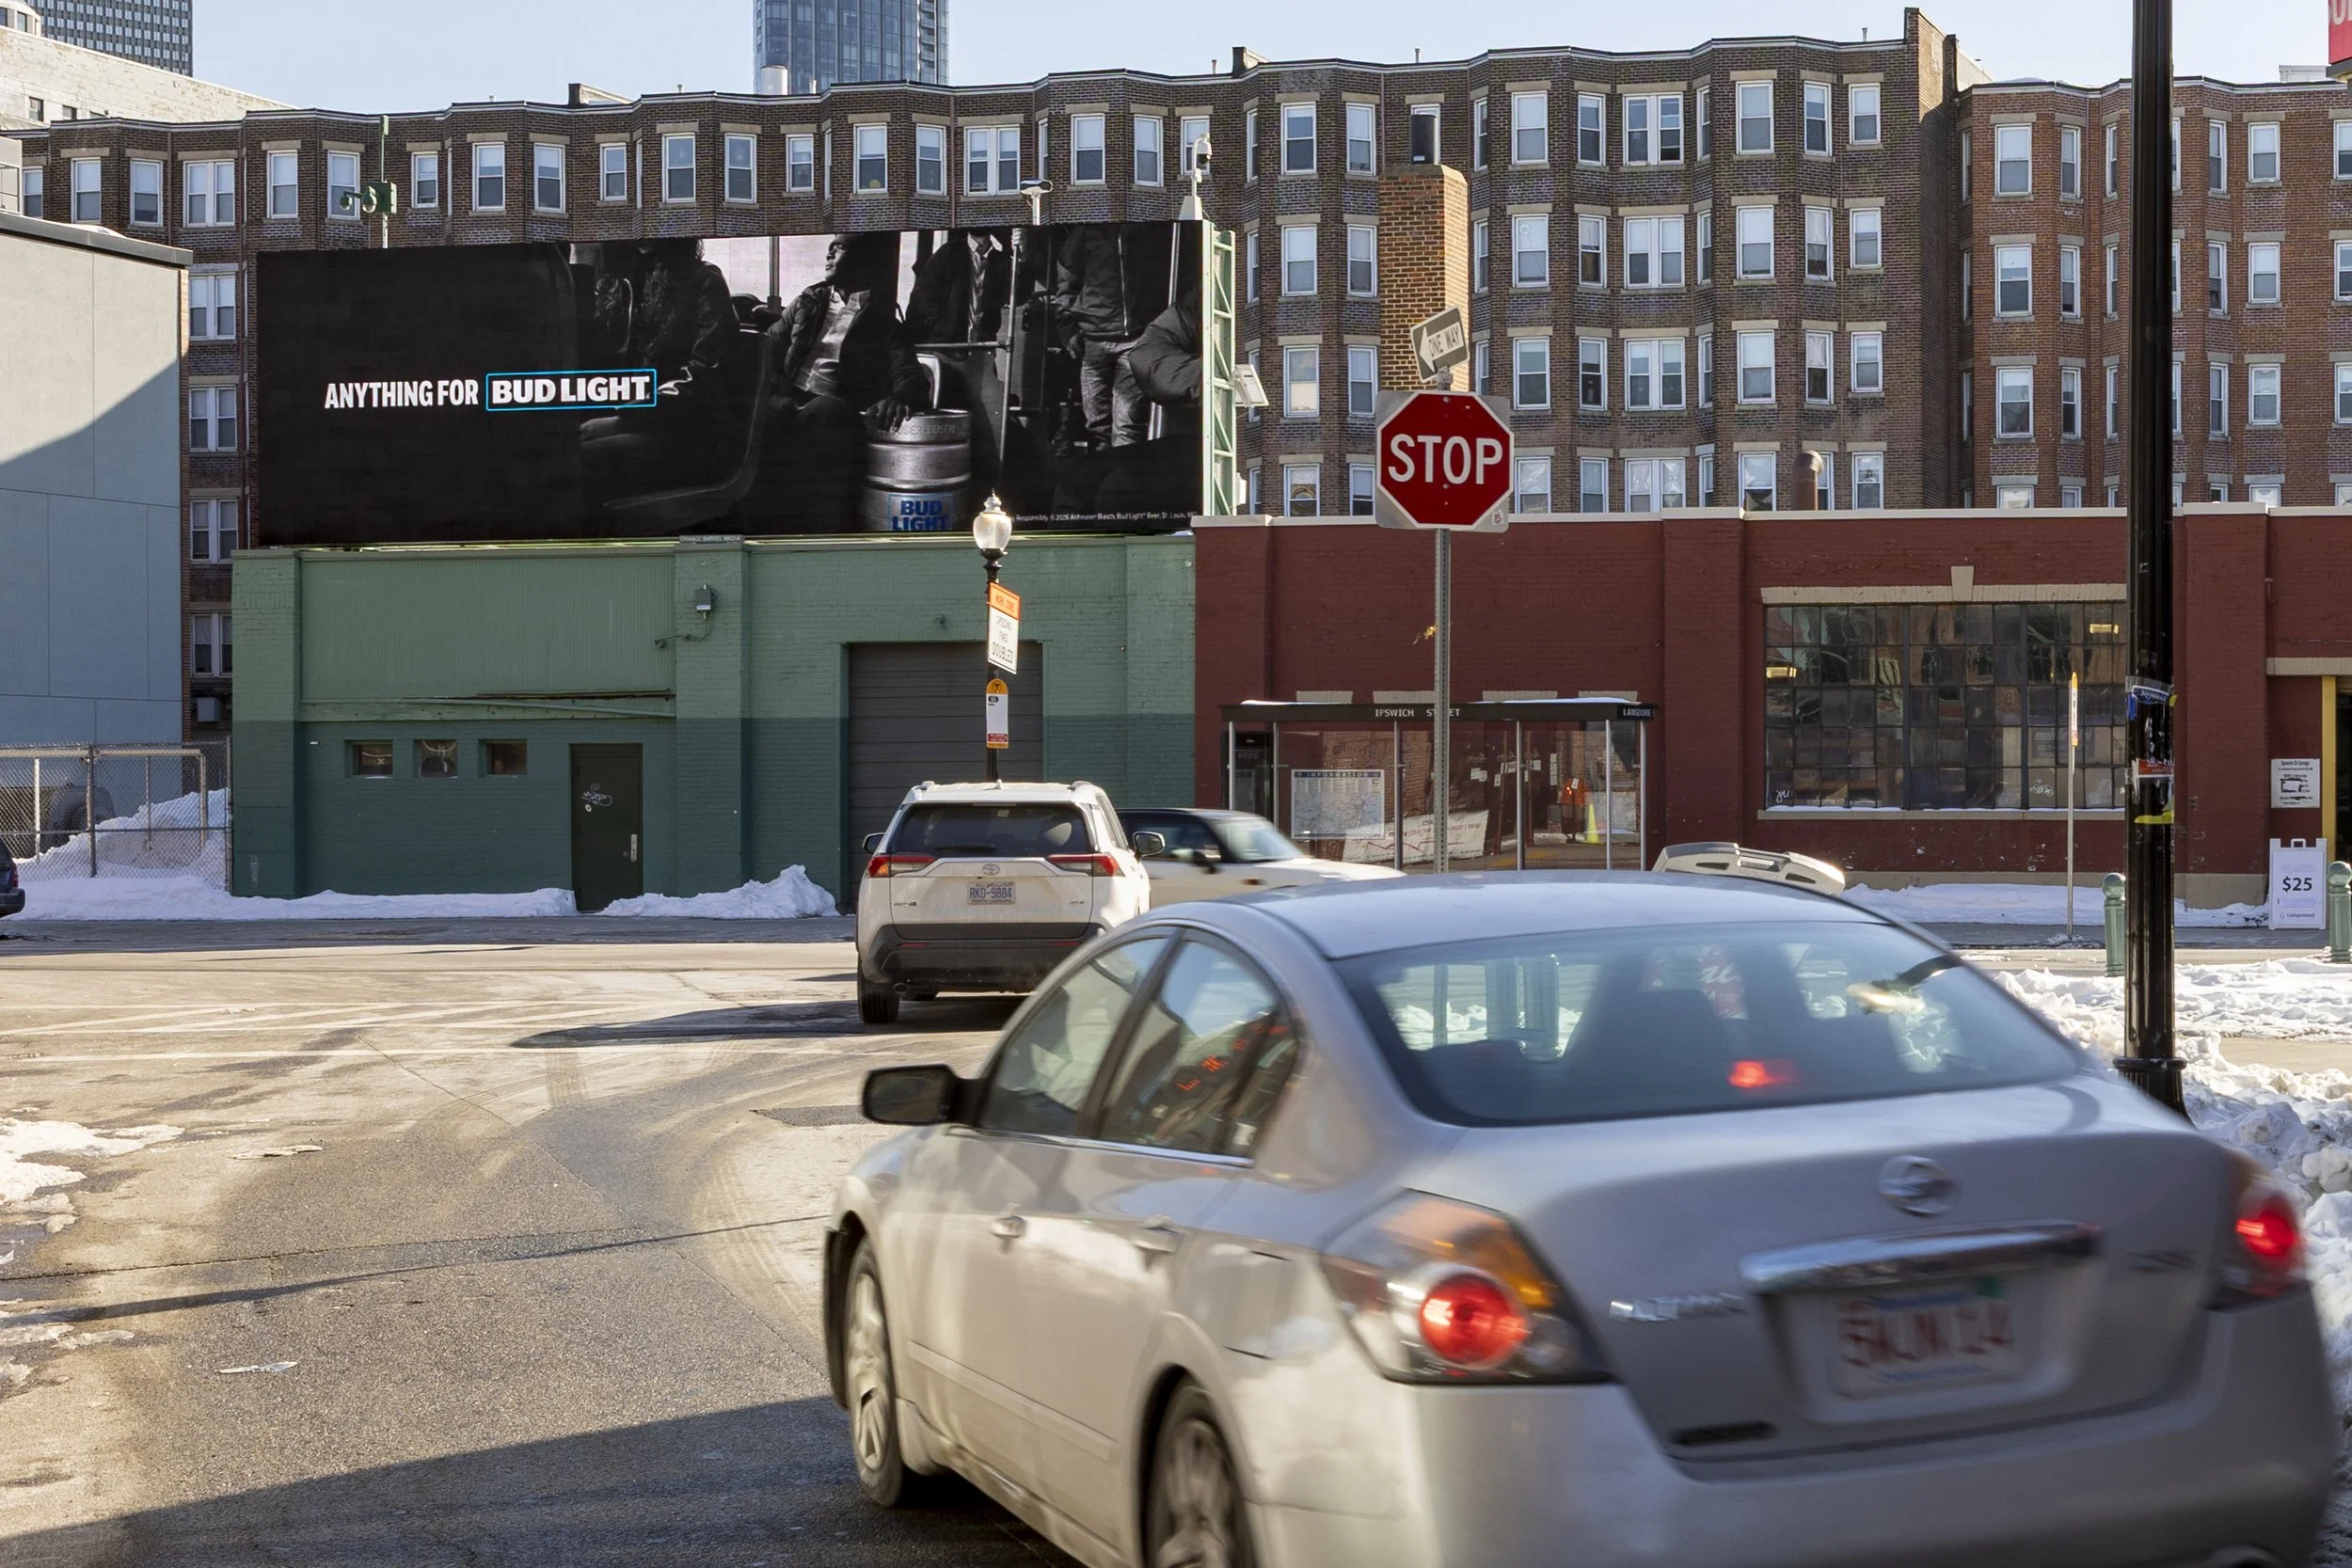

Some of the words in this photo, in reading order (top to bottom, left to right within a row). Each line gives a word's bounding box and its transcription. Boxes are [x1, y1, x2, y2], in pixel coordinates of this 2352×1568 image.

[1428, 334, 1444, 357] ONE
[1443, 325, 1460, 349] WAY
[325, 379, 434, 409] ANYTHING
[437, 378, 479, 406] FOR
[492, 378, 556, 404] BUD
[561, 376, 650, 403] LIGHT
[1388, 433, 1503, 484] STOP
[900, 500, 944, 515] BUD
[892, 515, 949, 531] LIGHT
[1117, 512, 1128, 520] Bud
[1375, 708, 1415, 718] IPSWICH
[1426, 708, 1461, 717] STET
[2282, 876, 2312, 893] $25
